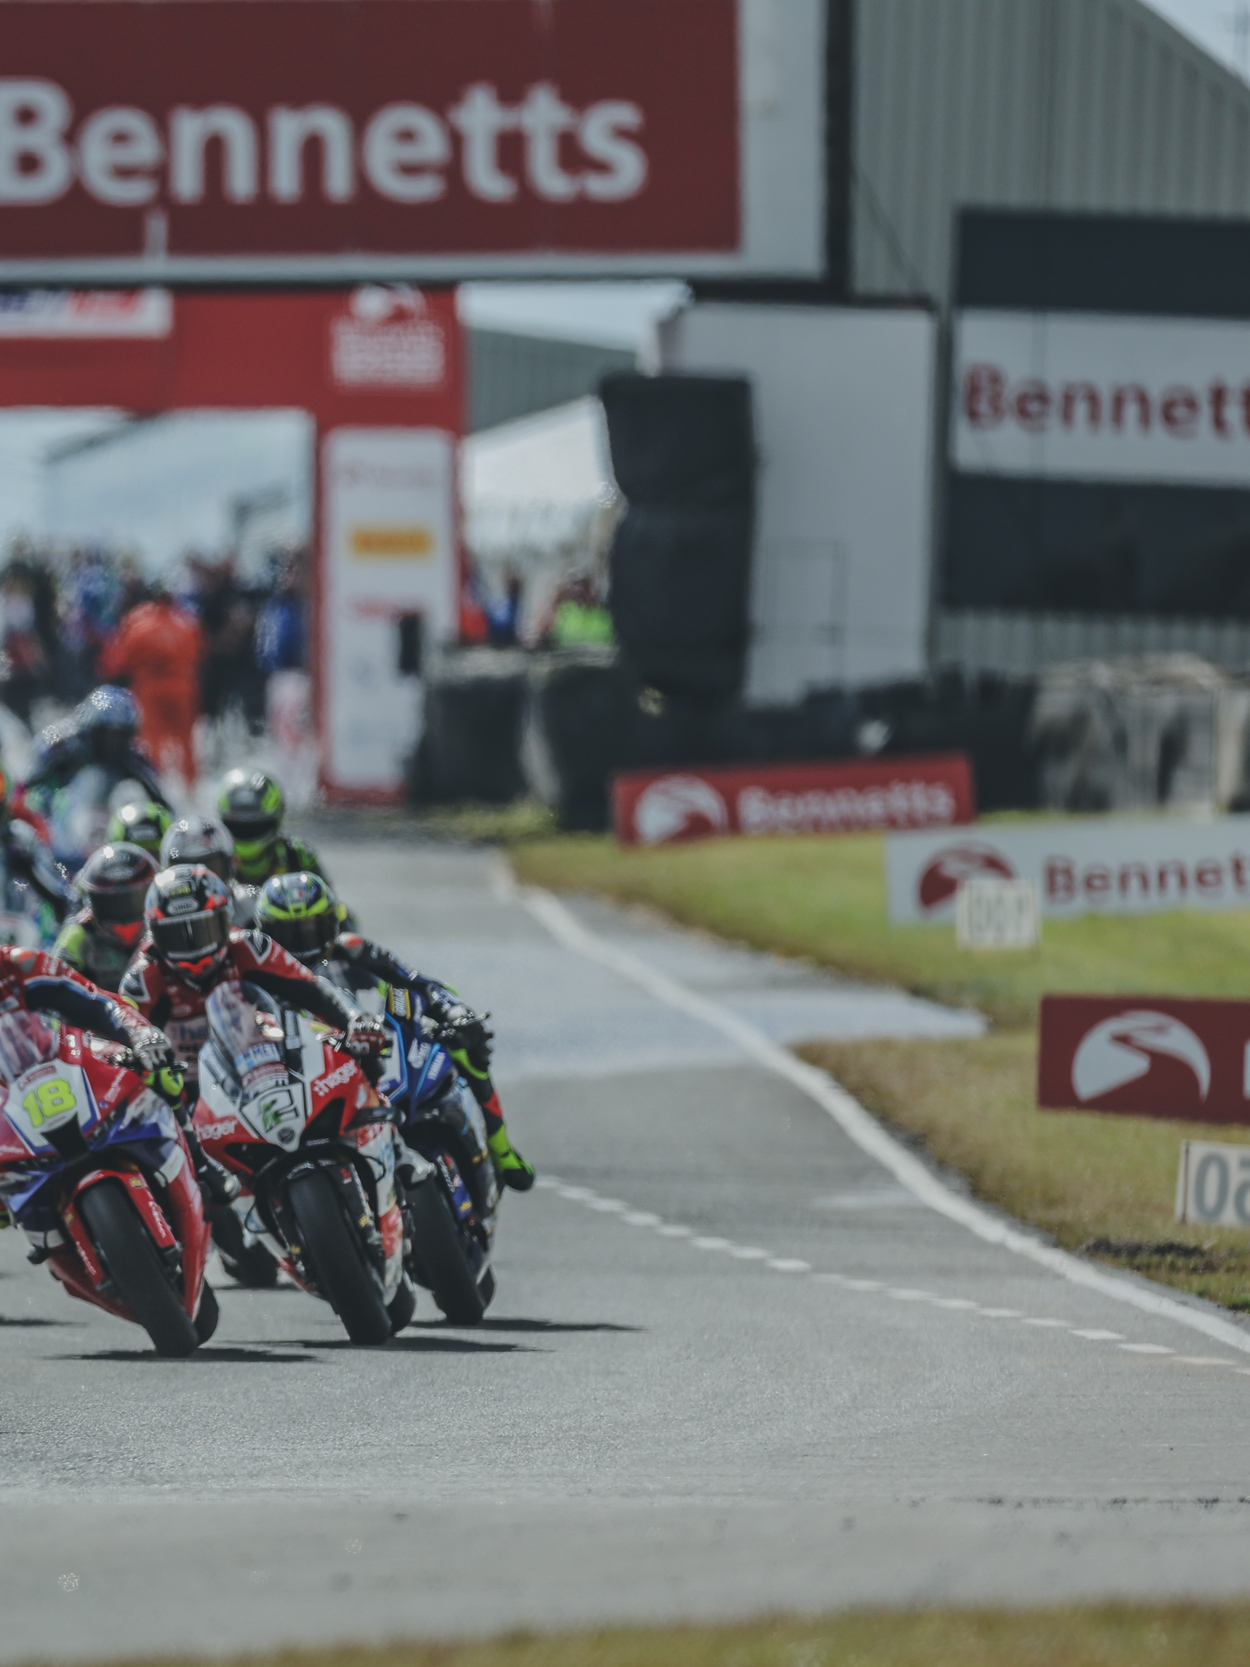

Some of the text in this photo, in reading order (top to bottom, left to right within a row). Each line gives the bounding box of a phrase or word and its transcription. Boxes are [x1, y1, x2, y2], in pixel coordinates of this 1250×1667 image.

[736, 777, 955, 834] Bennetts
[22, 1078, 77, 1128] 18
[262, 1088, 299, 1134] 2
